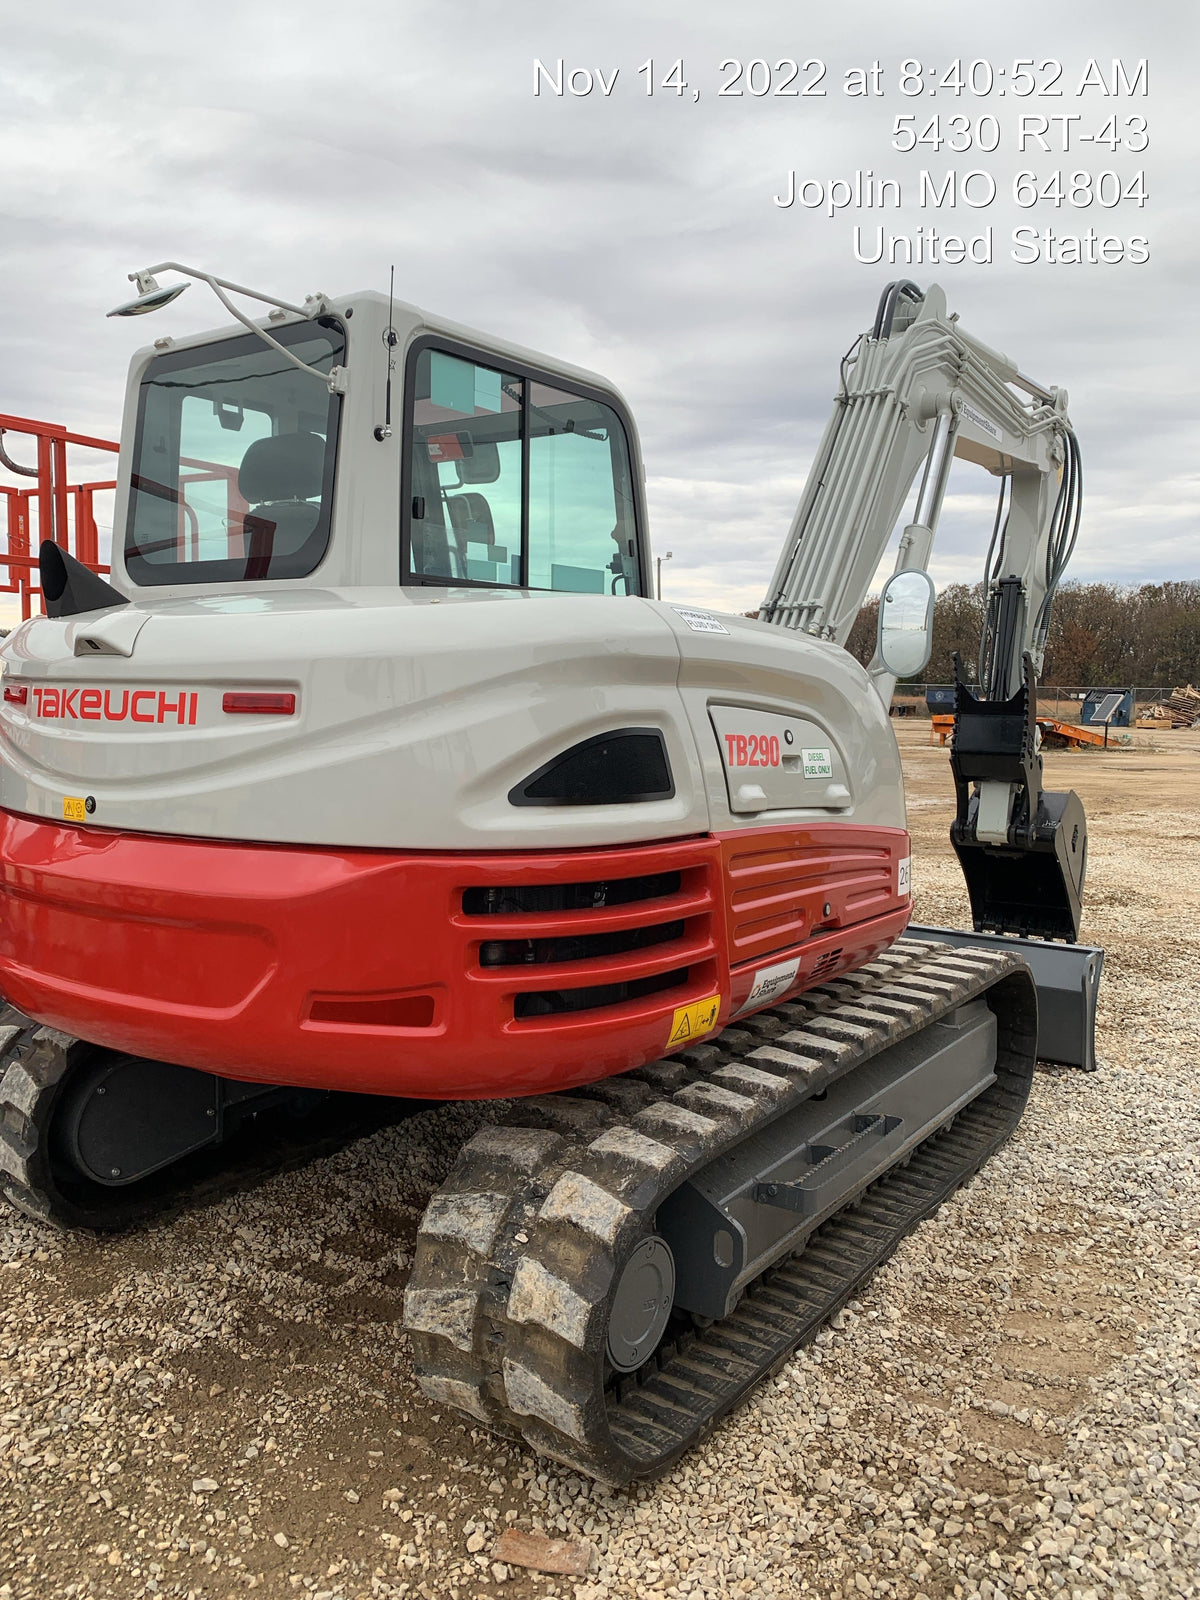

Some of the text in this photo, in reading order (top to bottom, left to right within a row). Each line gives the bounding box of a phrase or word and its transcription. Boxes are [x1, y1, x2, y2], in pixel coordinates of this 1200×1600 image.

[725, 734, 780, 767] TB290
[807, 752, 825, 762] DIESEL
[804, 765, 831, 775] FUEL ONLY
